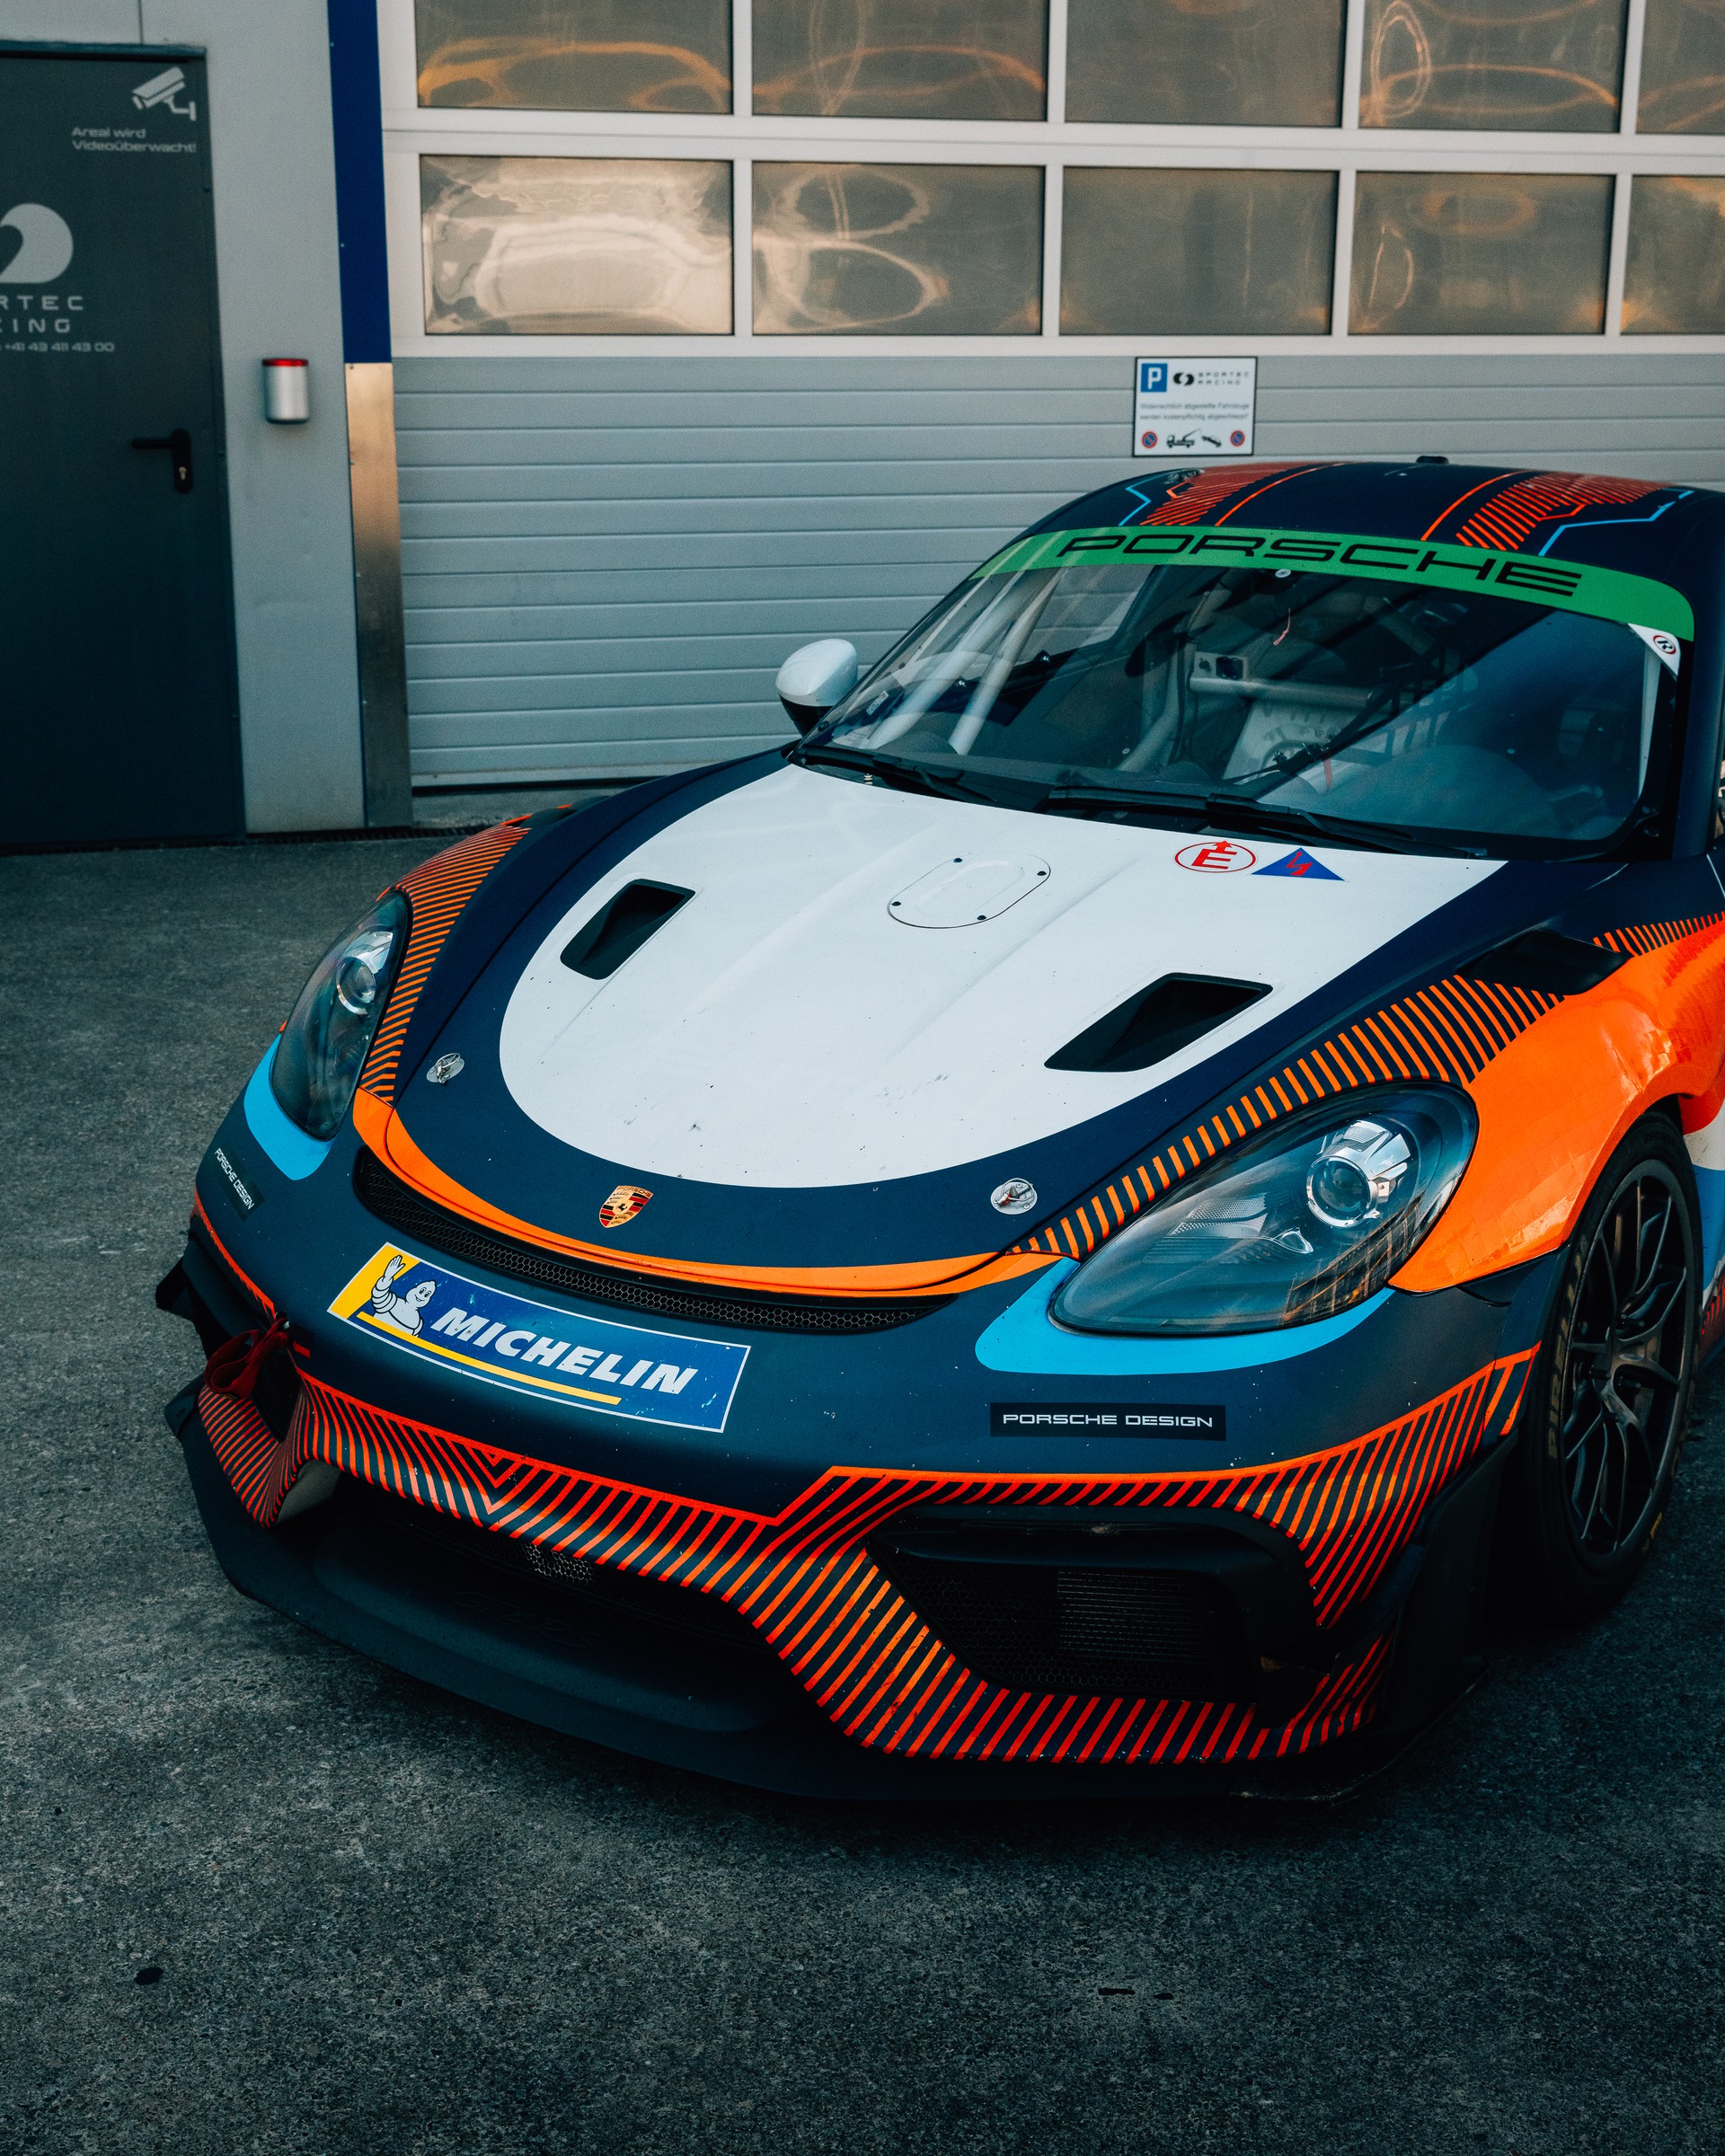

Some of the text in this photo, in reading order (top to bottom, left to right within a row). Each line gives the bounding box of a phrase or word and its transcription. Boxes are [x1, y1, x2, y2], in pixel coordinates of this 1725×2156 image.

[71, 126, 147, 139] Areal wird
[0, 318, 71, 333] ING
[1147, 367, 1162, 390] P
[1056, 534, 1582, 596] PORSCHE
[215, 1147, 255, 1210] PORSCHE DESIGN
[617, 1186, 652, 1198] PORSCHE
[429, 1307, 699, 1395] MICHELIN
[1003, 1414, 1213, 1427] PORSCHE DESIGN
